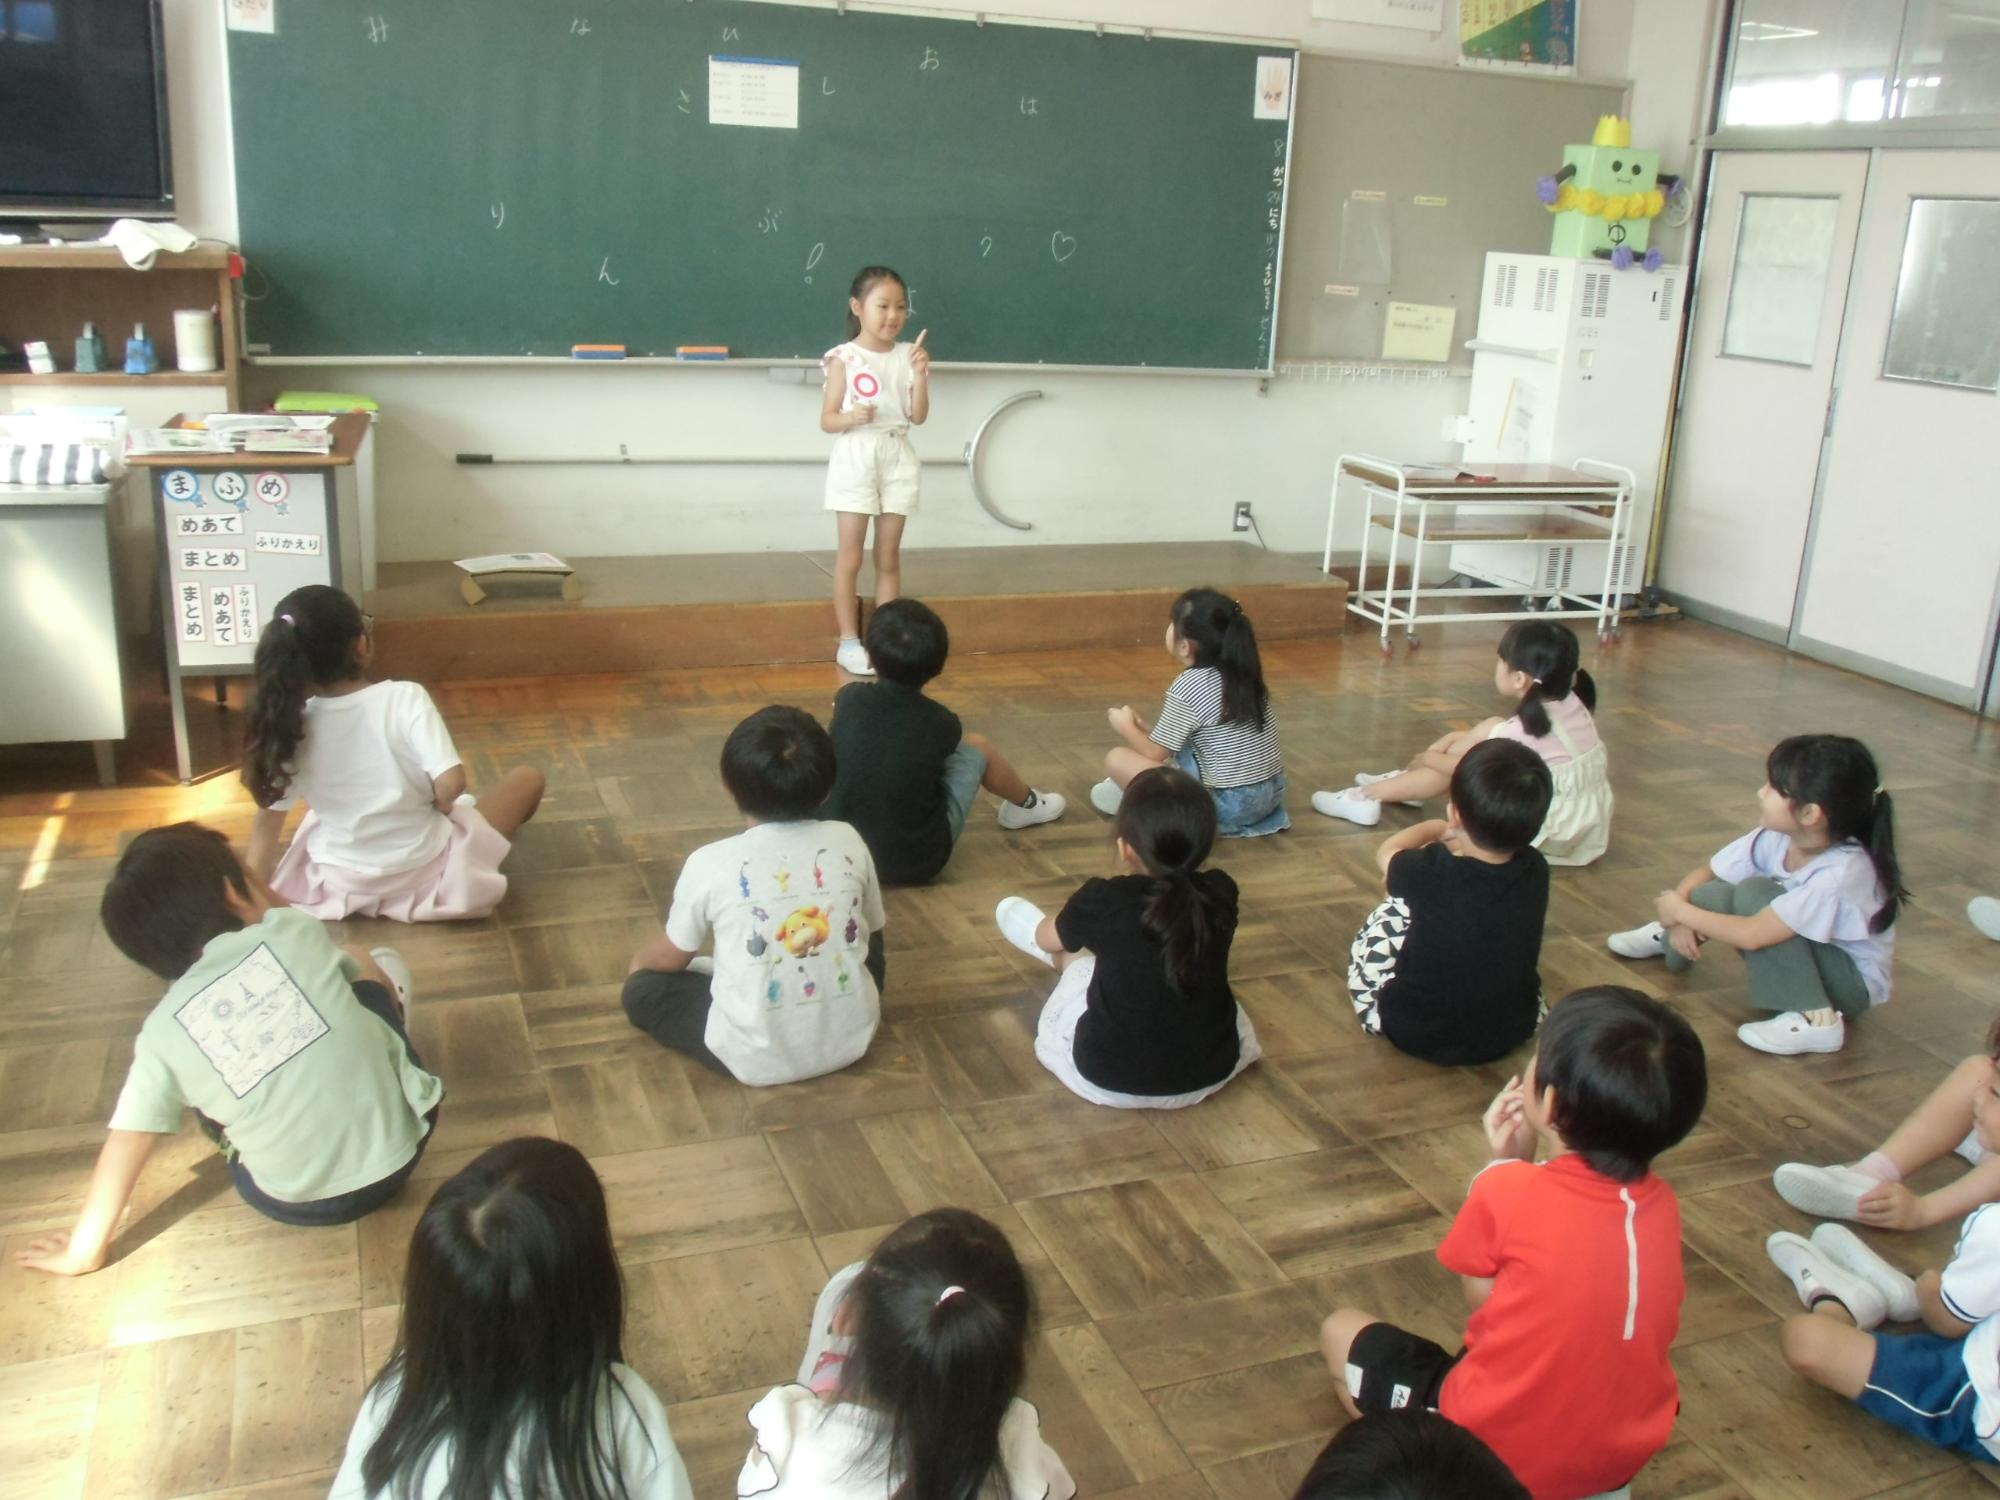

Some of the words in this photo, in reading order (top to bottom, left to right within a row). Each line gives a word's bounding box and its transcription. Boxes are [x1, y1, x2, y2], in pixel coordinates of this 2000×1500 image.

[919, 46, 940, 71] お
[1020, 95, 1039, 115] は
[171, 474, 190, 494] ま
[218, 477, 241, 495] ふ
[262, 478, 282, 497] め
[181, 517, 237, 533] めあて
[256, 537, 320, 550] ふりかえり
[184, 551, 240, 567] まとめ
[183, 586, 203, 637] まとめ
[213, 591, 232, 643] めあて
[239, 586, 253, 638] ふりかえり
